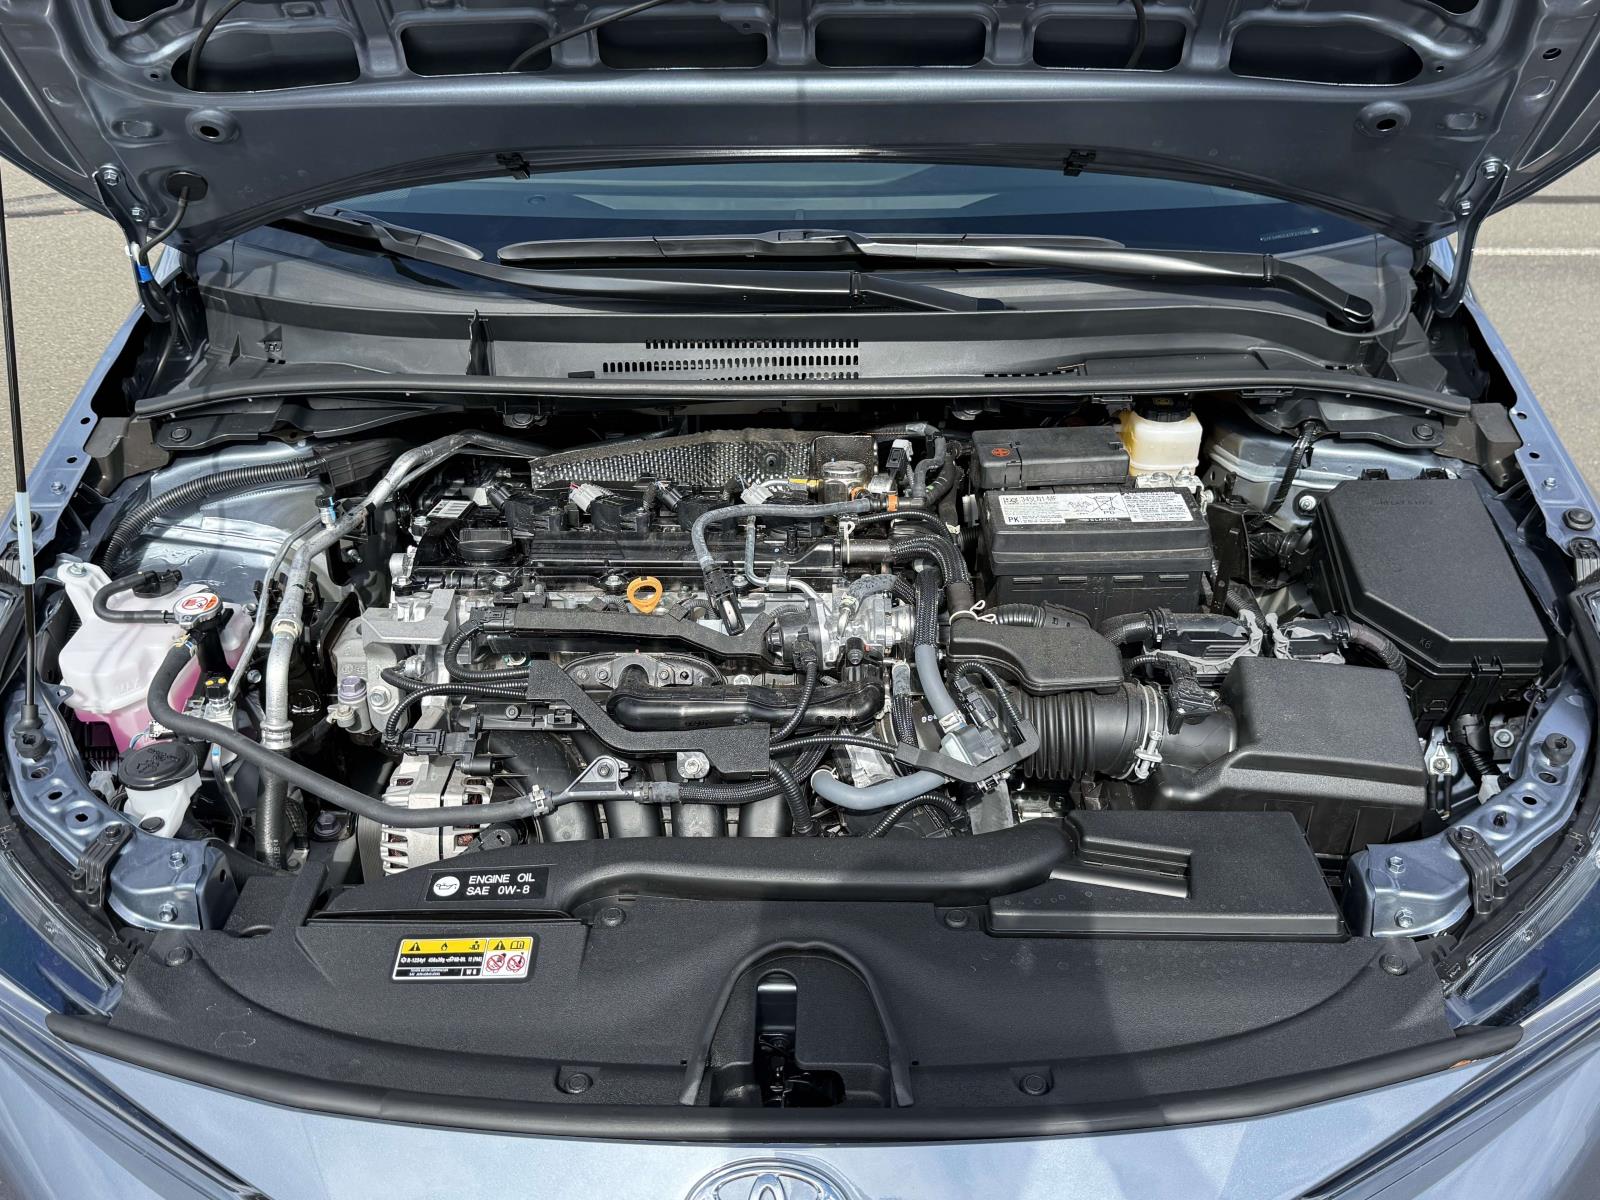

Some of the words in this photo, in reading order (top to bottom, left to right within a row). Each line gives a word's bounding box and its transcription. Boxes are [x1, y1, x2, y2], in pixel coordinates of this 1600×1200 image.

[468, 873, 511, 885] ENGINE
[517, 872, 536, 883] OIL
[466, 886, 490, 896] SAE
[497, 885, 531, 895] 0W-8
